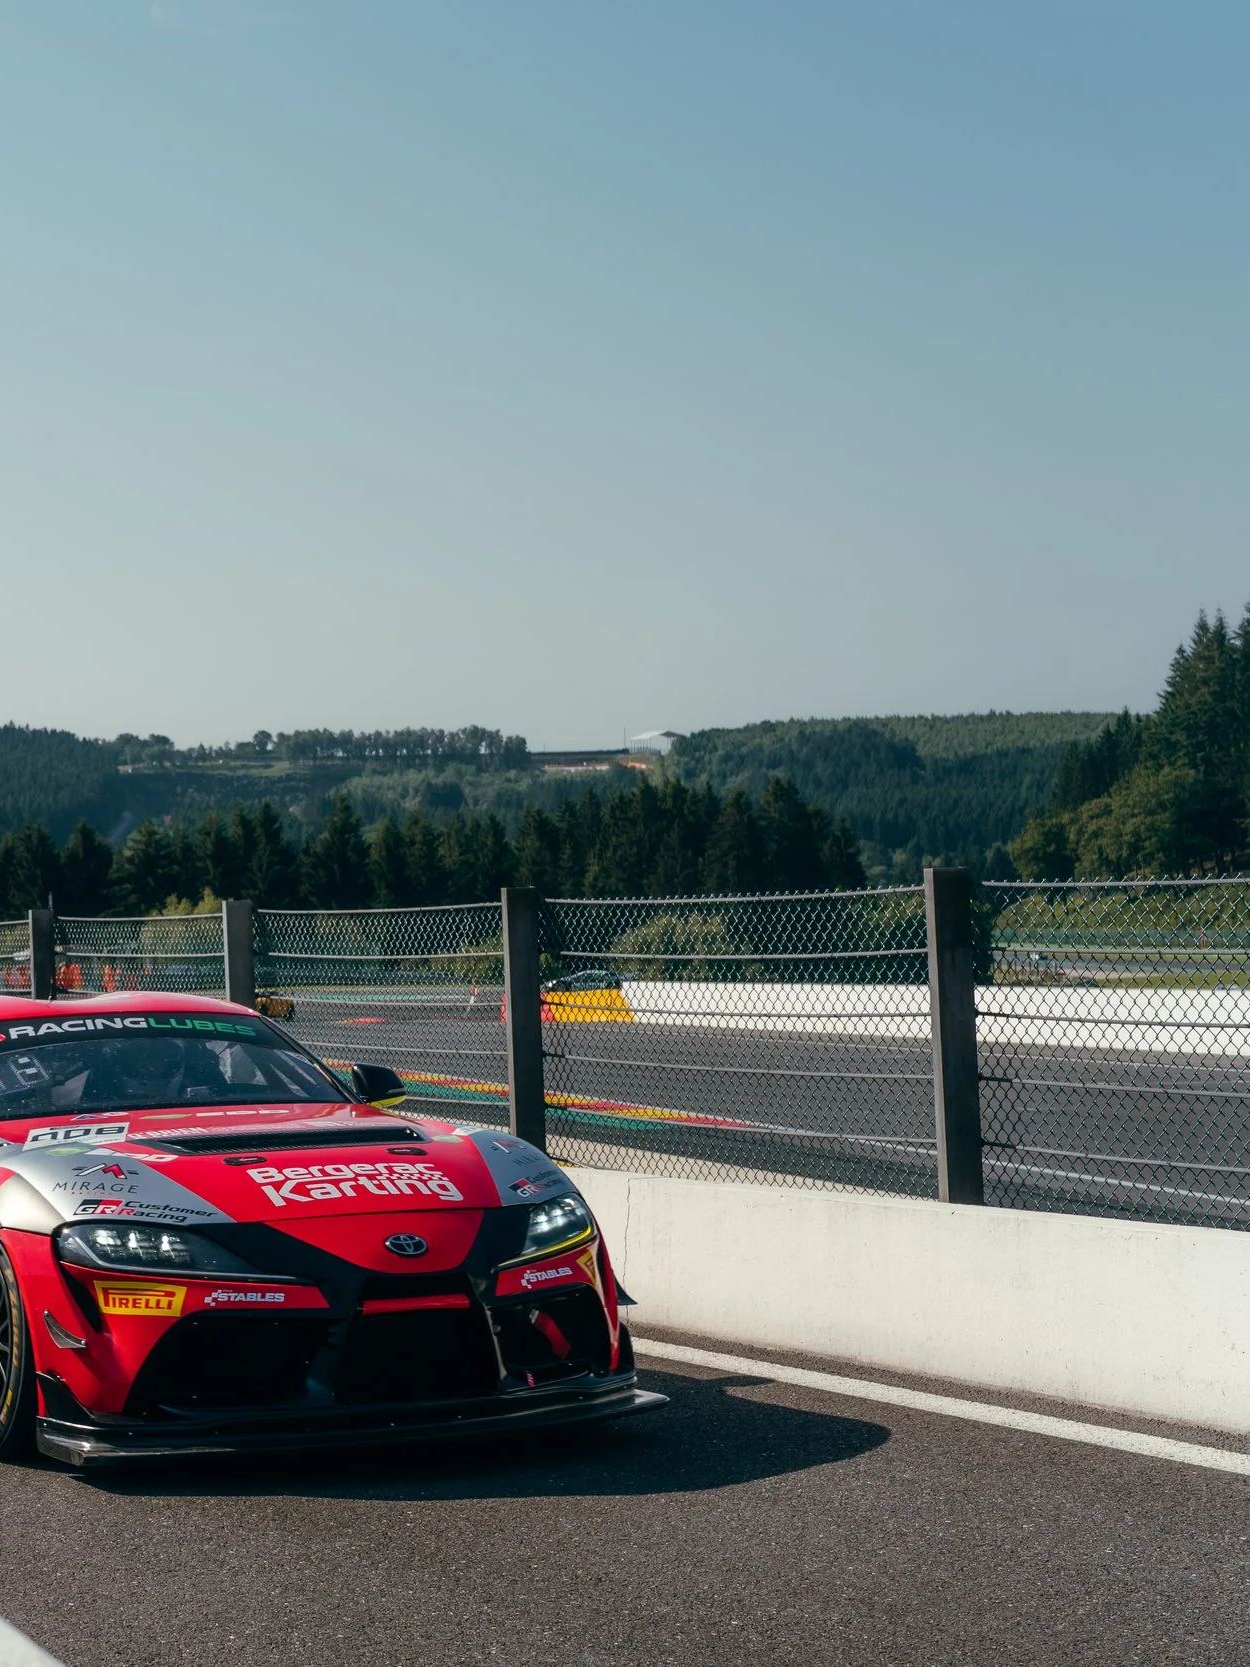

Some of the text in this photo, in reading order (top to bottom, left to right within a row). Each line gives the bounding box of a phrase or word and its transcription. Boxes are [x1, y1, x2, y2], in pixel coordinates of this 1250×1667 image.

[8, 1017, 257, 1040] RACINGLUBES
[246, 1162, 443, 1184] Bergerac
[52, 1181, 140, 1194] MIRAGE
[261, 1174, 464, 1207] Karting
[75, 1204, 119, 1215] GR
[117, 1208, 188, 1223] Racing
[124, 1200, 218, 1217] Customer
[529, 1266, 573, 1283] STABLES
[101, 1287, 177, 1310] PIRELLI
[217, 1292, 285, 1302] STABLES
